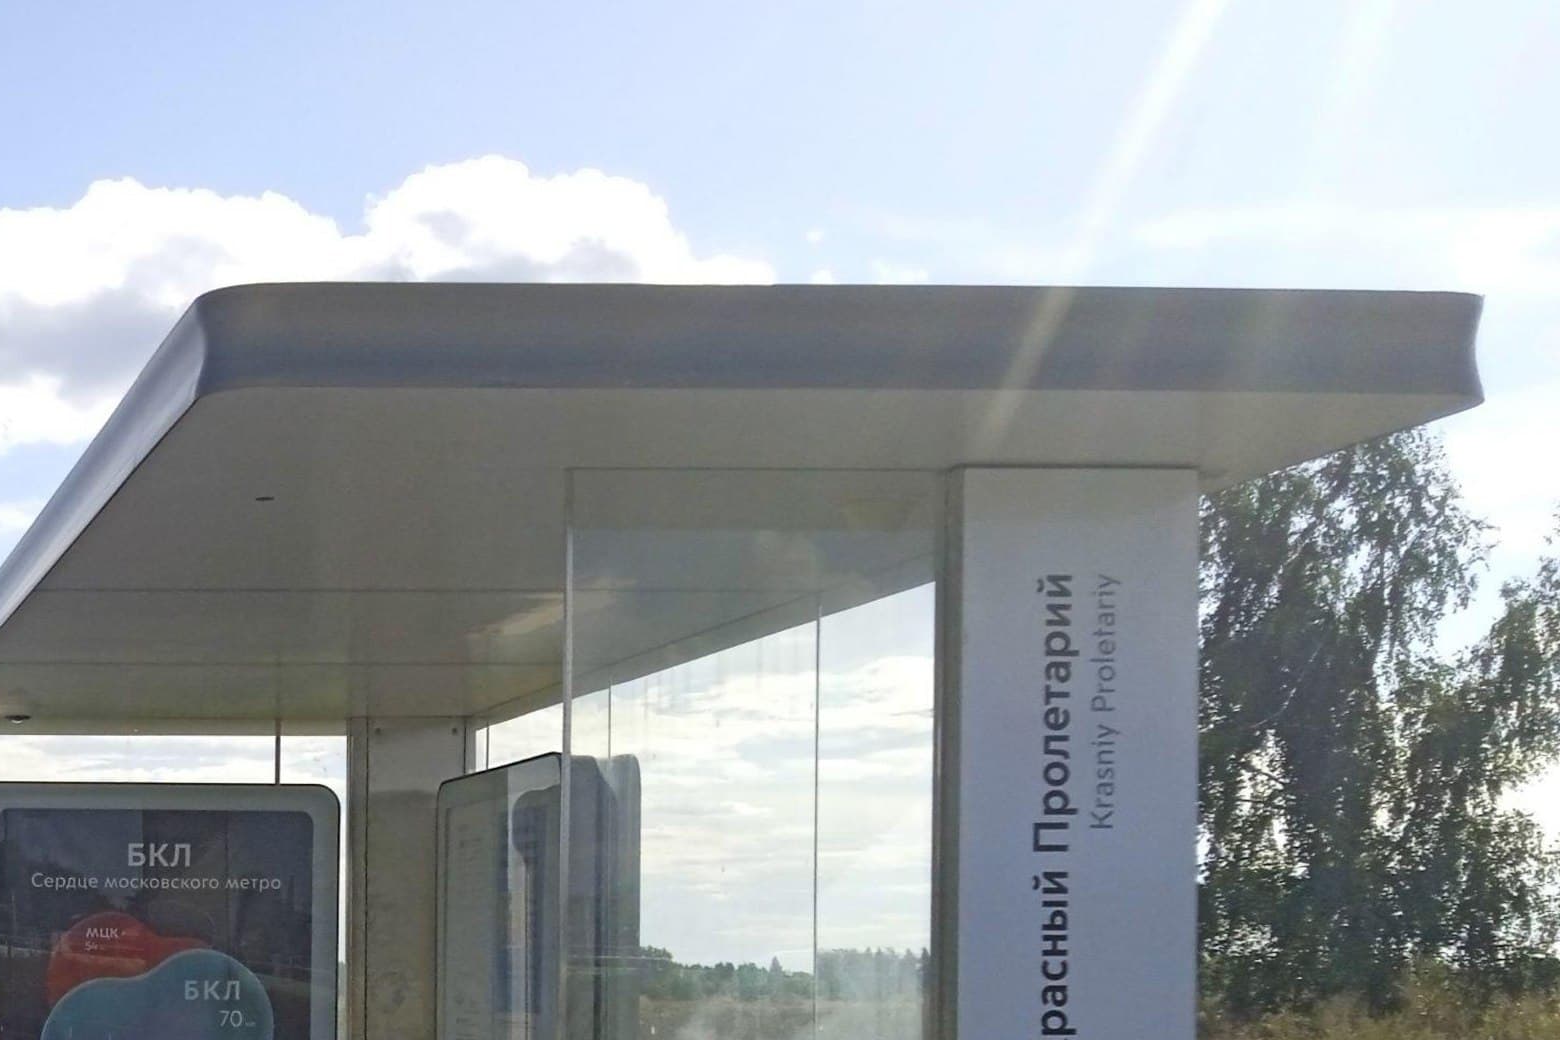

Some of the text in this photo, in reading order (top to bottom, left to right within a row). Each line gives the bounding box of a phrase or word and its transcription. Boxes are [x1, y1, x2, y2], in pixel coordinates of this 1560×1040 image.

[1088, 573, 1120, 830] Krasniy Proletariy
[1032, 573, 1079, 853] Пролетарий
[127, 842, 191, 867] БКЛ
[31, 872, 282, 892] Сердце московского метро
[85, 927, 119, 940] МЦК
[184, 979, 241, 1001] БКЛ
[218, 1010, 243, 1027] 70
